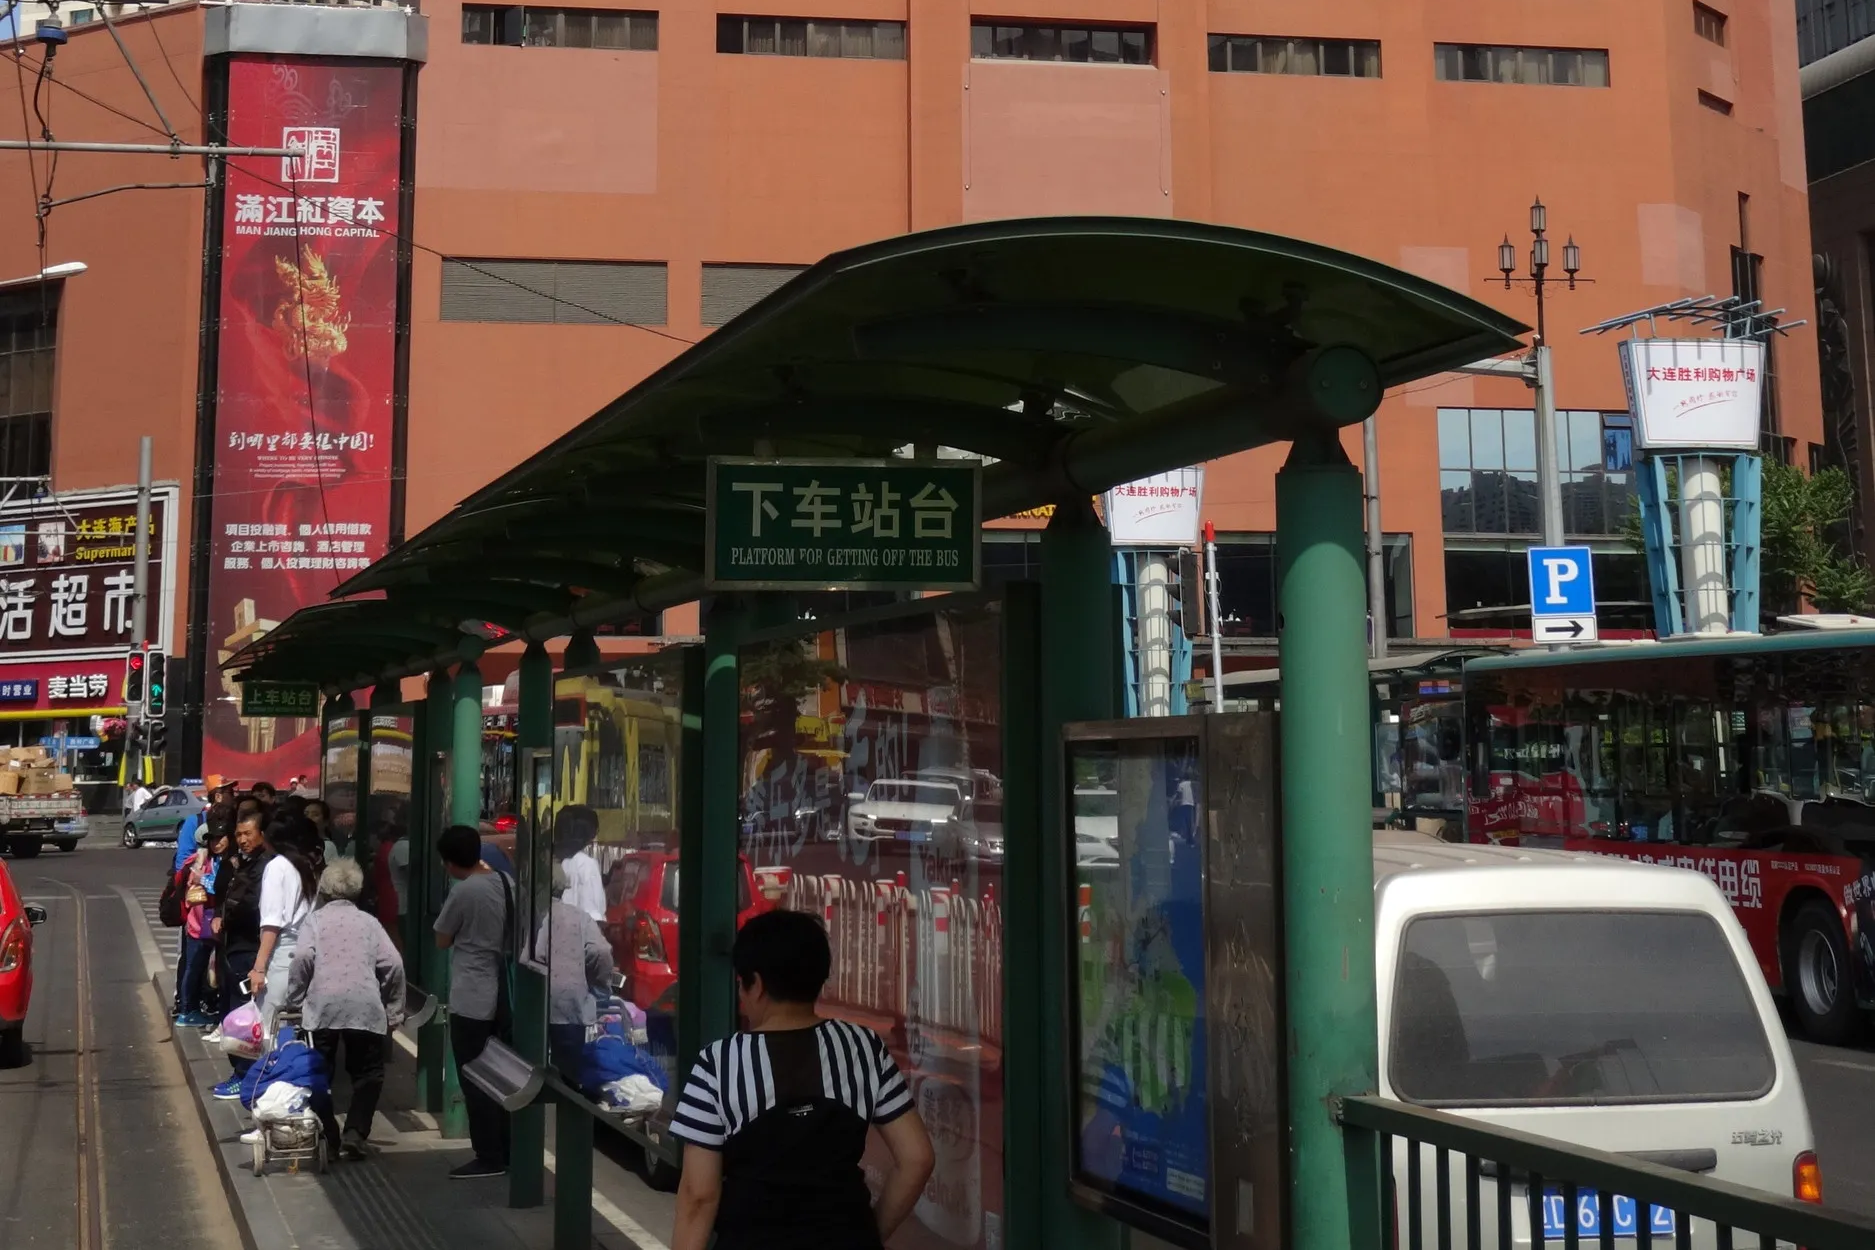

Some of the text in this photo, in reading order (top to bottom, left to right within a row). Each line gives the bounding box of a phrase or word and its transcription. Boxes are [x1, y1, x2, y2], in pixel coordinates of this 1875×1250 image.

[235, 194, 385, 225] 滿江紅資本
[236, 225, 380, 238] MAN JIANG HONG CAPITAL
[1647, 366, 1756, 383] 大连胜利购物广场
[1115, 485, 1198, 498] 大连胜利购物广场
[732, 479, 960, 539] 下车站台
[76, 544, 152, 561] Supermart
[731, 547, 796, 566] PLATFORM
[827, 548, 879, 566] GETTING
[882, 549, 906, 567] OFF
[909, 549, 933, 567] THE
[936, 549, 960, 568] BUS
[1542, 559, 1579, 604] P
[48, 673, 109, 699] 麦当劳
[248, 689, 313, 705] 上车站台
